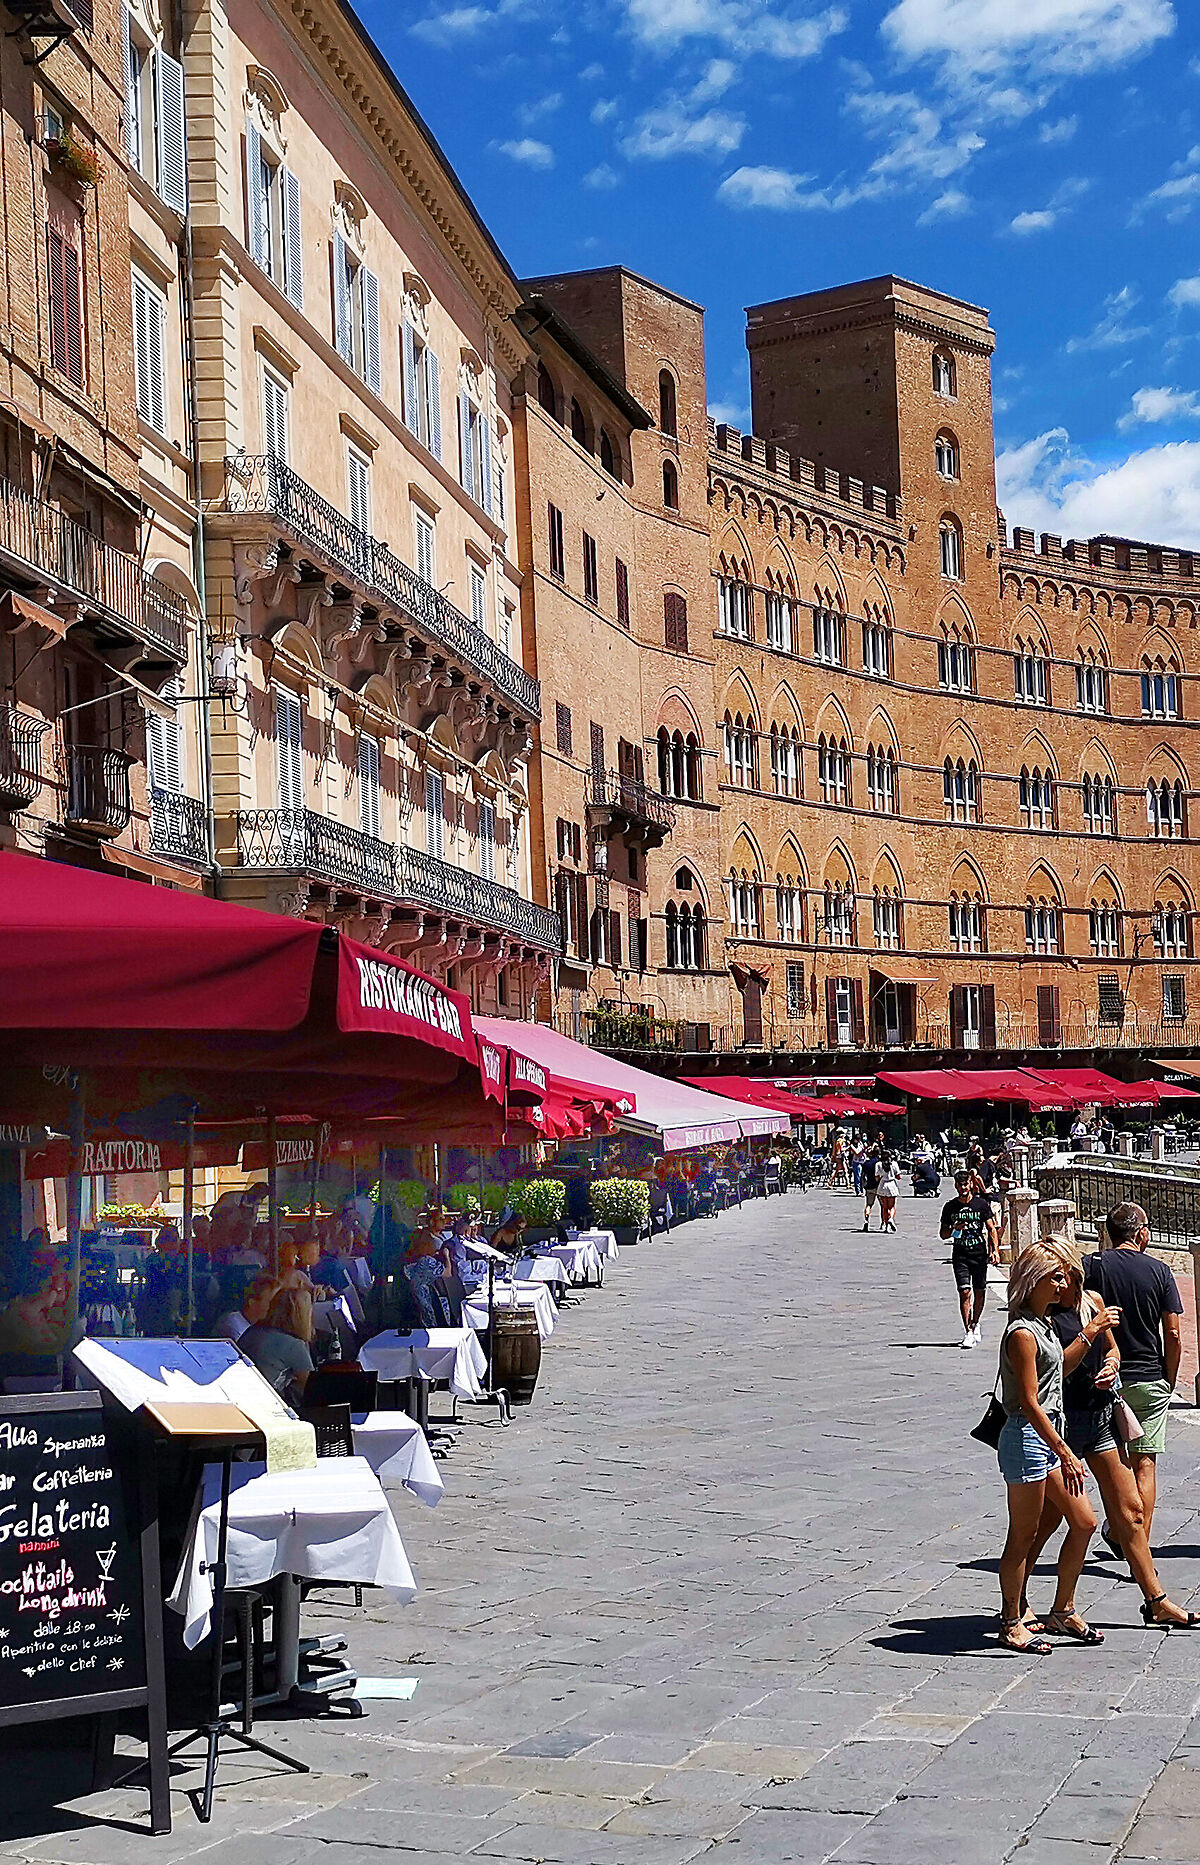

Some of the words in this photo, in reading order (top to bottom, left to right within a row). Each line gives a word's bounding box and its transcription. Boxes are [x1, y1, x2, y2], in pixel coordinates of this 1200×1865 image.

[355, 957, 438, 1028] RISTORANTE
[436, 990, 464, 1042] BAR
[82, 1140, 162, 1173] RATTORIA
[274, 1139, 315, 1166] IZZERIA
[42, 1434, 106, 1459] Speranza
[0, 1473, 16, 1491] ar
[32, 1465, 113, 1492] Caffetteria
[0, 1498, 110, 1543] Gelateria
[0, 1559, 75, 1595] ocktails
[60, 1580, 107, 1608] drink
[33, 1621, 61, 1638] dalle
[1, 1640, 55, 1660] Aperitivo
[60, 1643, 78, 1653] con
[82, 1638, 91, 1650] le
[93, 1633, 123, 1647] delizie
[36, 1656, 65, 1672] dello
